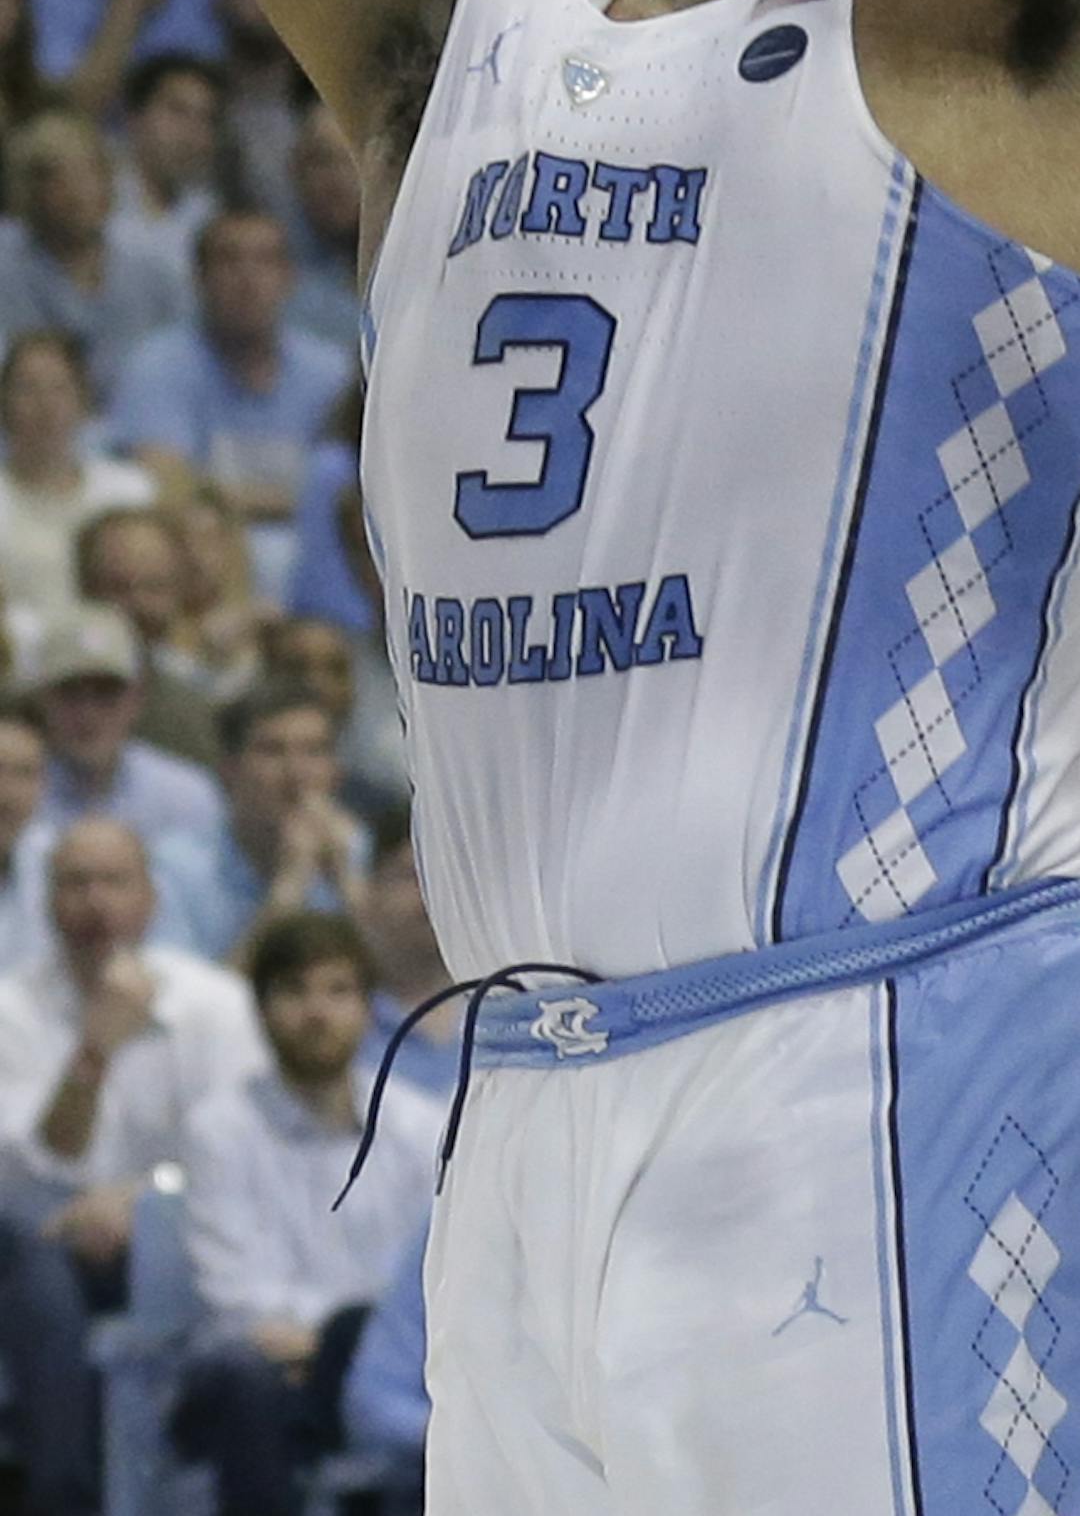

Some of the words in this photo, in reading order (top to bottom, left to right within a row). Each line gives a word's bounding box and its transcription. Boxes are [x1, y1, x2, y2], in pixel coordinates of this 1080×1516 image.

[447, 150, 707, 258] NORTH
[454, 292, 617, 540] 3
[405, 573, 704, 687] AROLINA
